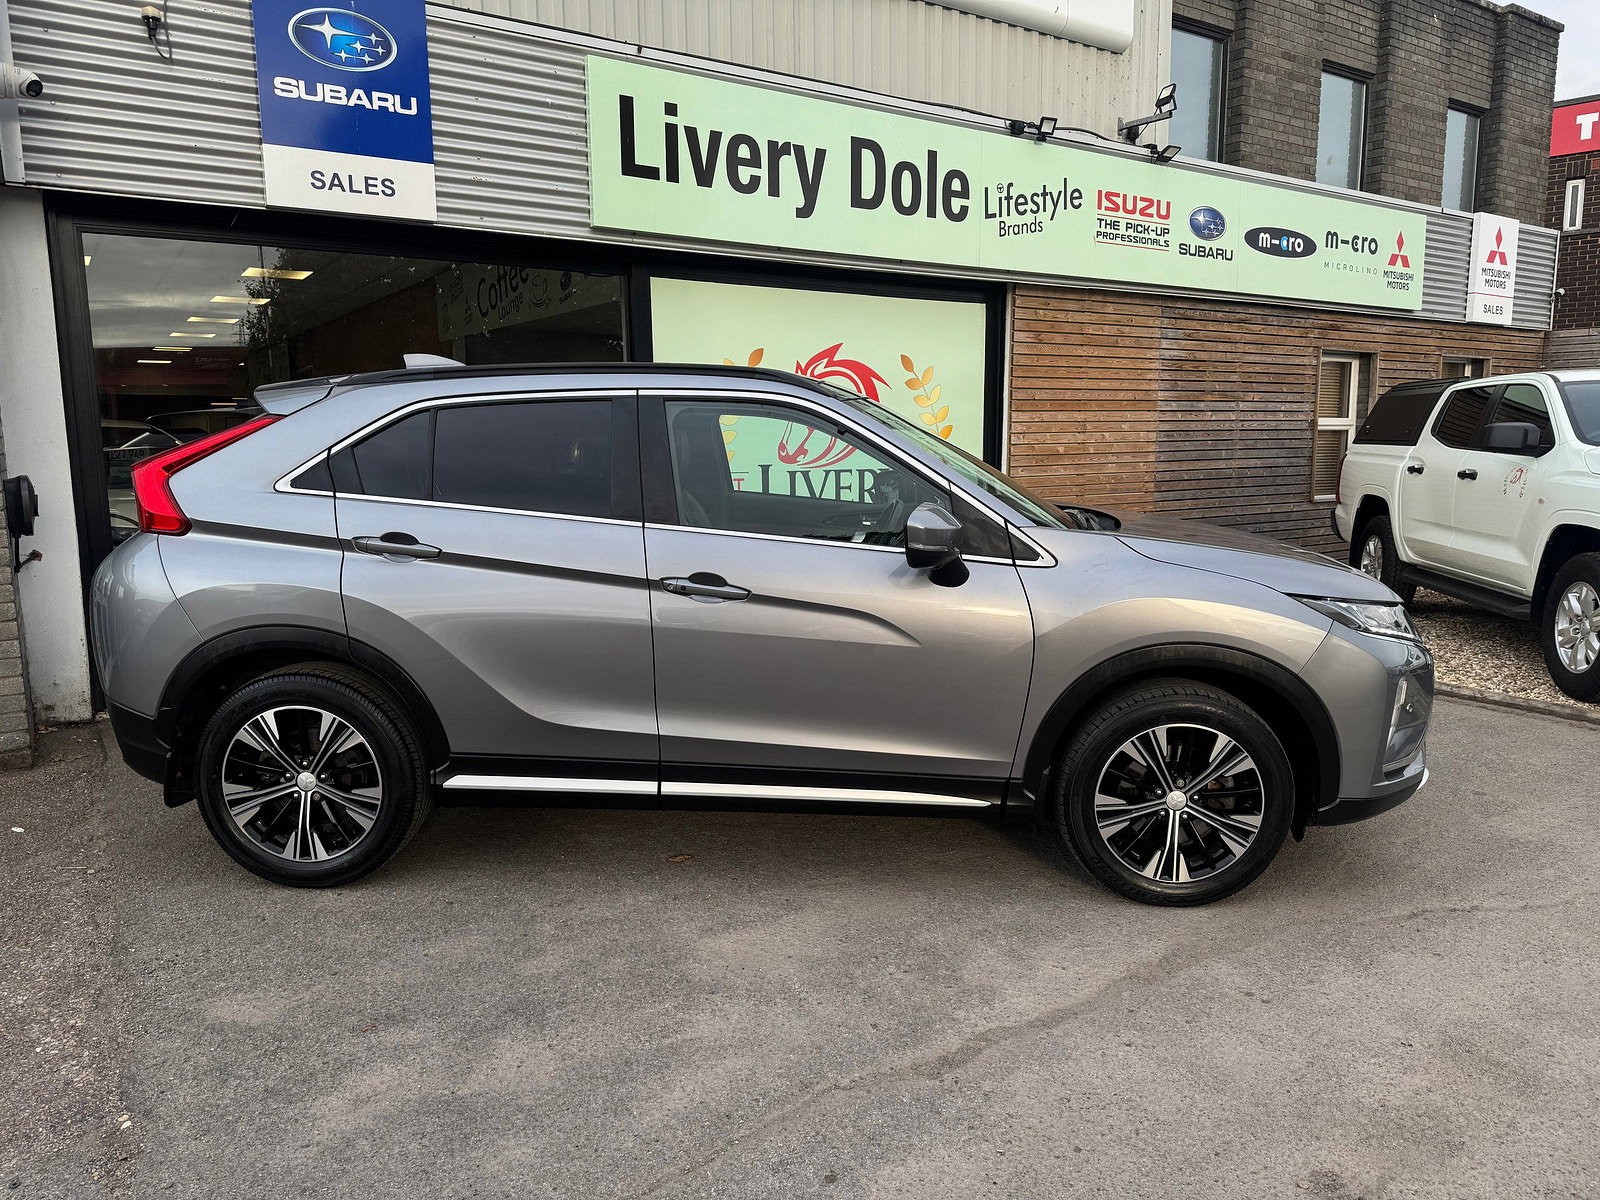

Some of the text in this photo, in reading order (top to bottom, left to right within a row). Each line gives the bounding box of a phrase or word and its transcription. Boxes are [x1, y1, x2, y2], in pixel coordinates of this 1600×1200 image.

[273, 76, 418, 116] SUBARU
[619, 94, 970, 223] Livery Dole
[310, 169, 396, 197] SALES
[984, 177, 1083, 221] Lifestyle
[1096, 189, 1171, 220] ISUZU
[998, 216, 1043, 238] Brands
[1097, 217, 1170, 238] THE PICK-UP
[1096, 230, 1170, 248] PROFESSIONALS
[1178, 242, 1234, 262] SUBARU
[1323, 261, 1378, 275] MICROLINO
[1382, 270, 1415, 281] MITSUBISHI
[1481, 267, 1511, 279] MITSUBISHI
[1386, 280, 1410, 291] MOTORS
[1484, 278, 1507, 289] MOTORS
[1483, 304, 1504, 315] SALES
